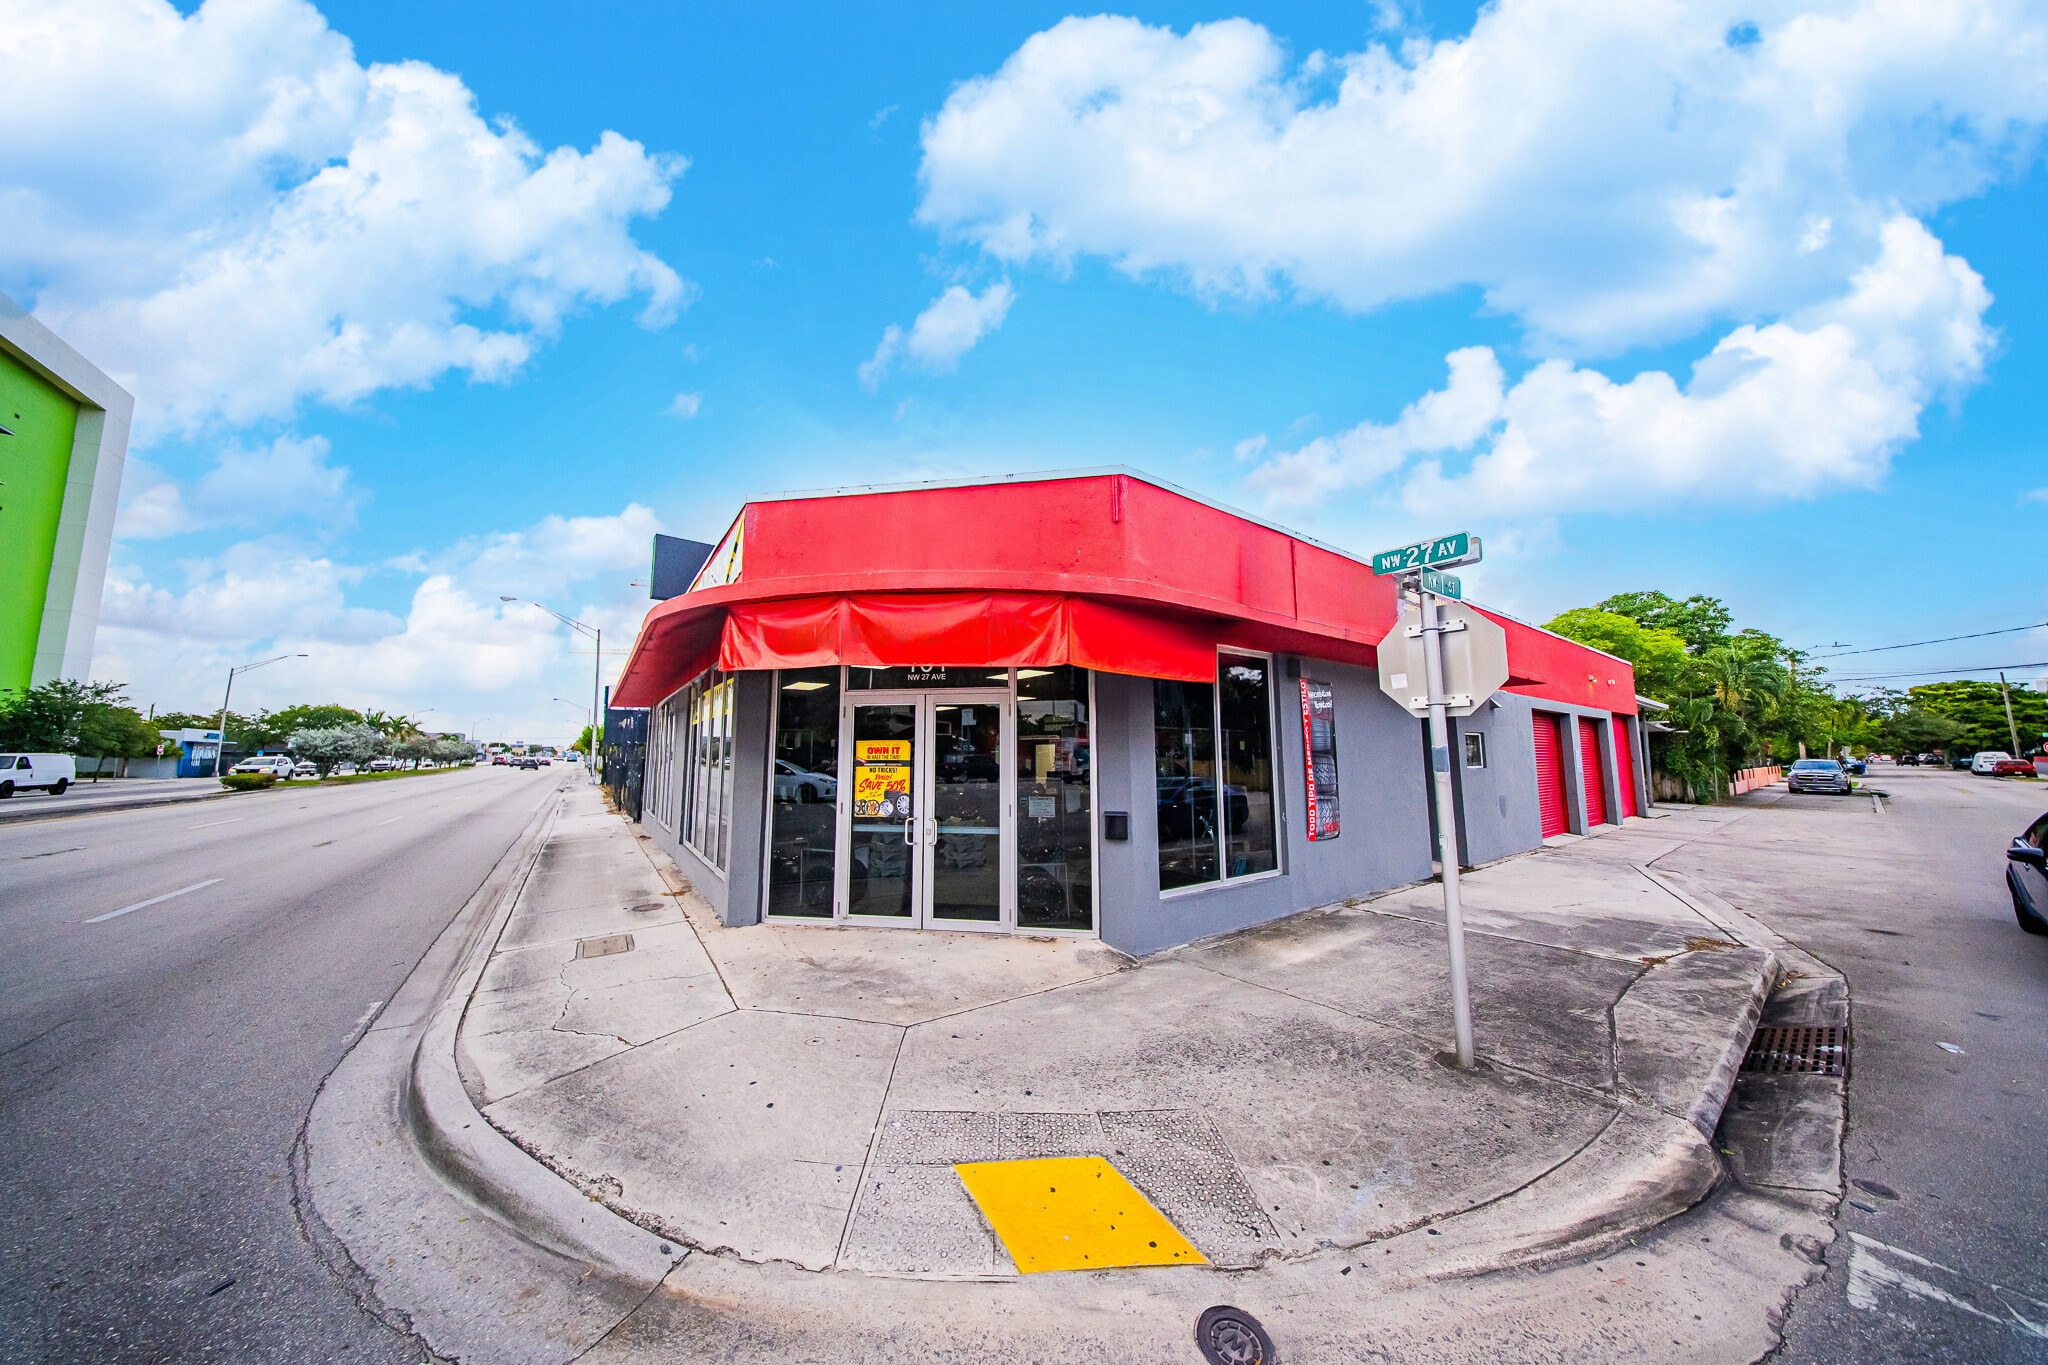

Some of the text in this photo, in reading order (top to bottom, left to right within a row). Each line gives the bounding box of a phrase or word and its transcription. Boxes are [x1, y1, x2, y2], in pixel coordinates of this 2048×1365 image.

[1381, 540, 1457, 570] NW 27 AV
[1441, 575, 1445, 594] 1
[1448, 581, 1456, 595] ST
[1300, 682, 1309, 716] ESTILO
[858, 777, 906, 793] SAVE 50%
[1308, 783, 1316, 807] TIPO
[1308, 809, 1316, 838] TODO
